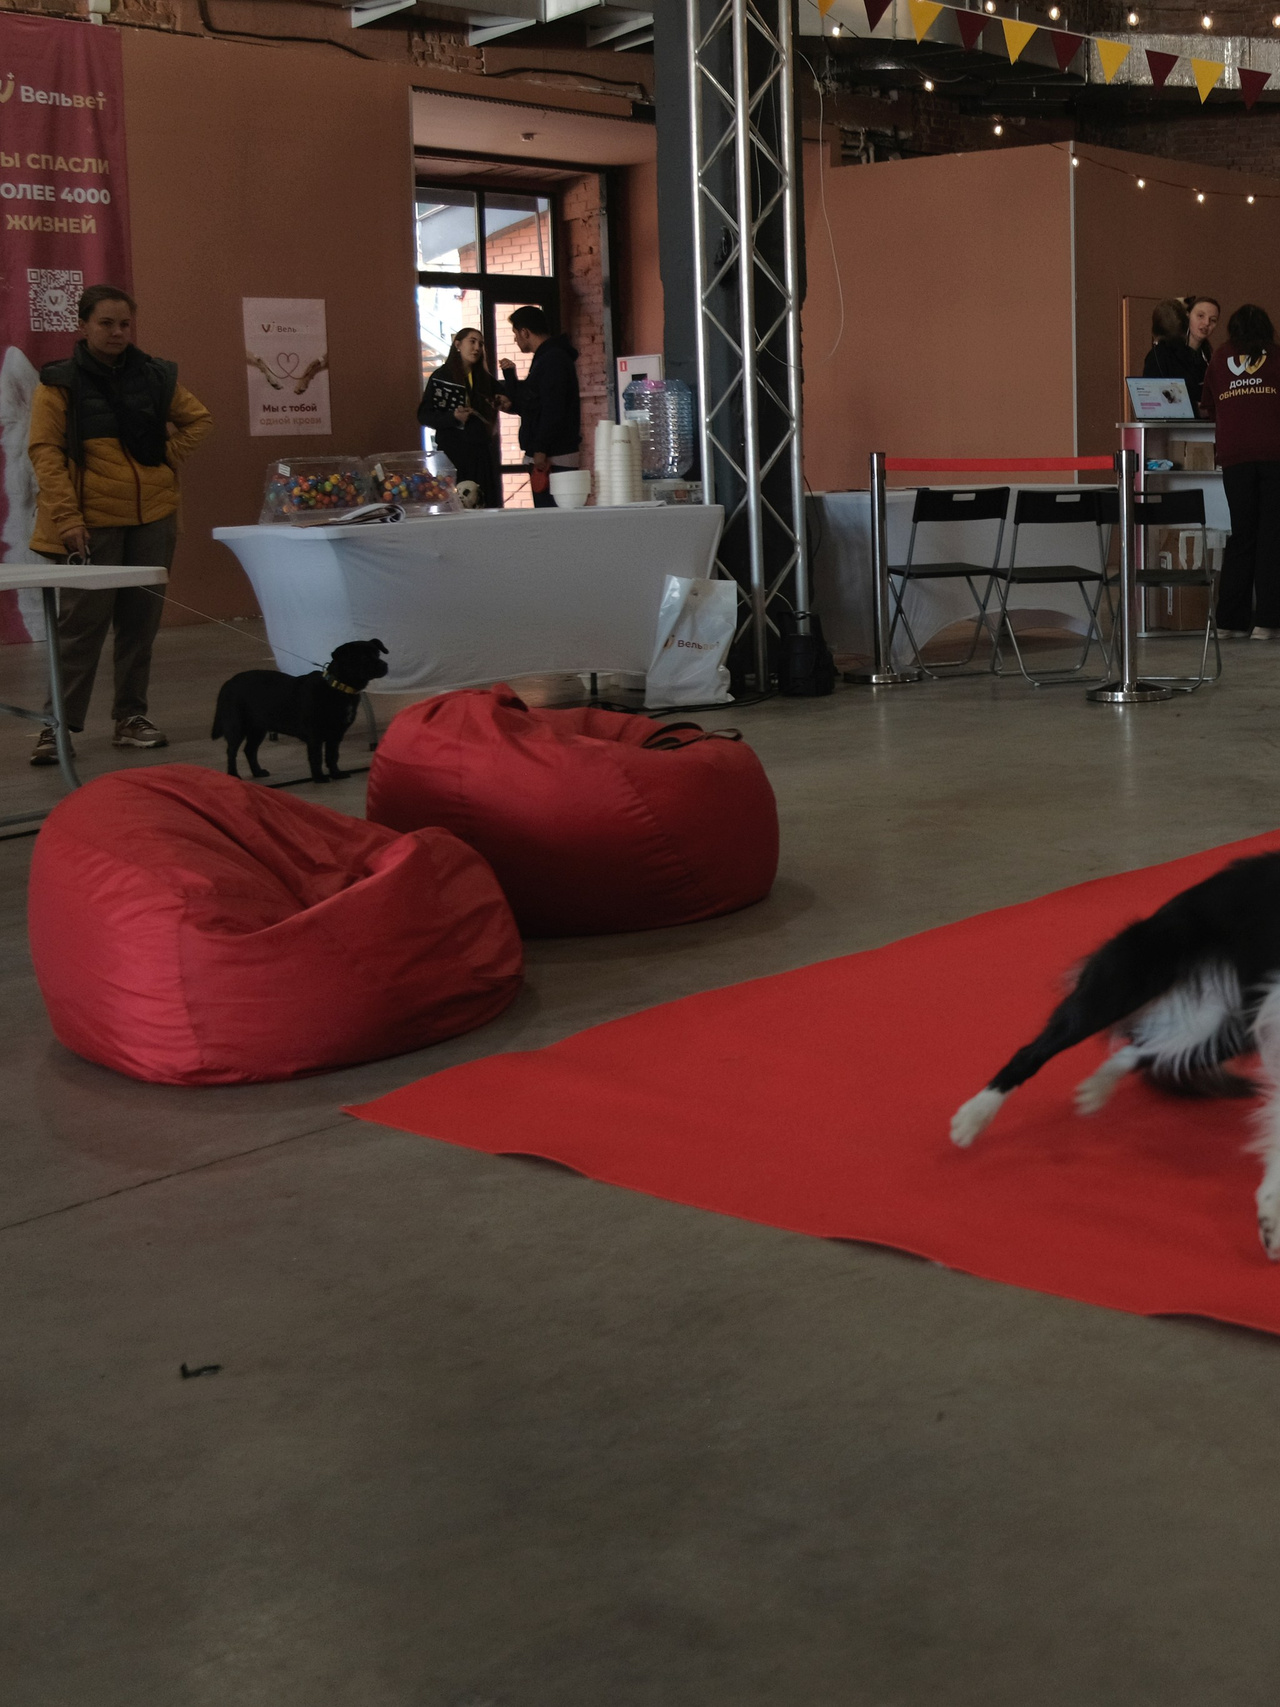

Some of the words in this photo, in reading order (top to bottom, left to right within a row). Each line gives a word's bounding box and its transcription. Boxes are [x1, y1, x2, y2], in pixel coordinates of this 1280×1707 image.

[20, 86, 107, 110] Вельвет
[0, 152, 20, 168] Ы
[26, 154, 110, 175] СПАСЛИ
[0, 183, 56, 202] ОЛЕЕ
[60, 187, 111, 205] 4000
[6, 214, 97, 234] ЖИЗНЕЙ
[1229, 378, 1263, 390] ДОНОР
[1218, 386, 1278, 401] ОБНИМАШЕК
[263, 404, 279, 412] Мы
[289, 403, 318, 412] тобой
[260, 416, 290, 425] одной
